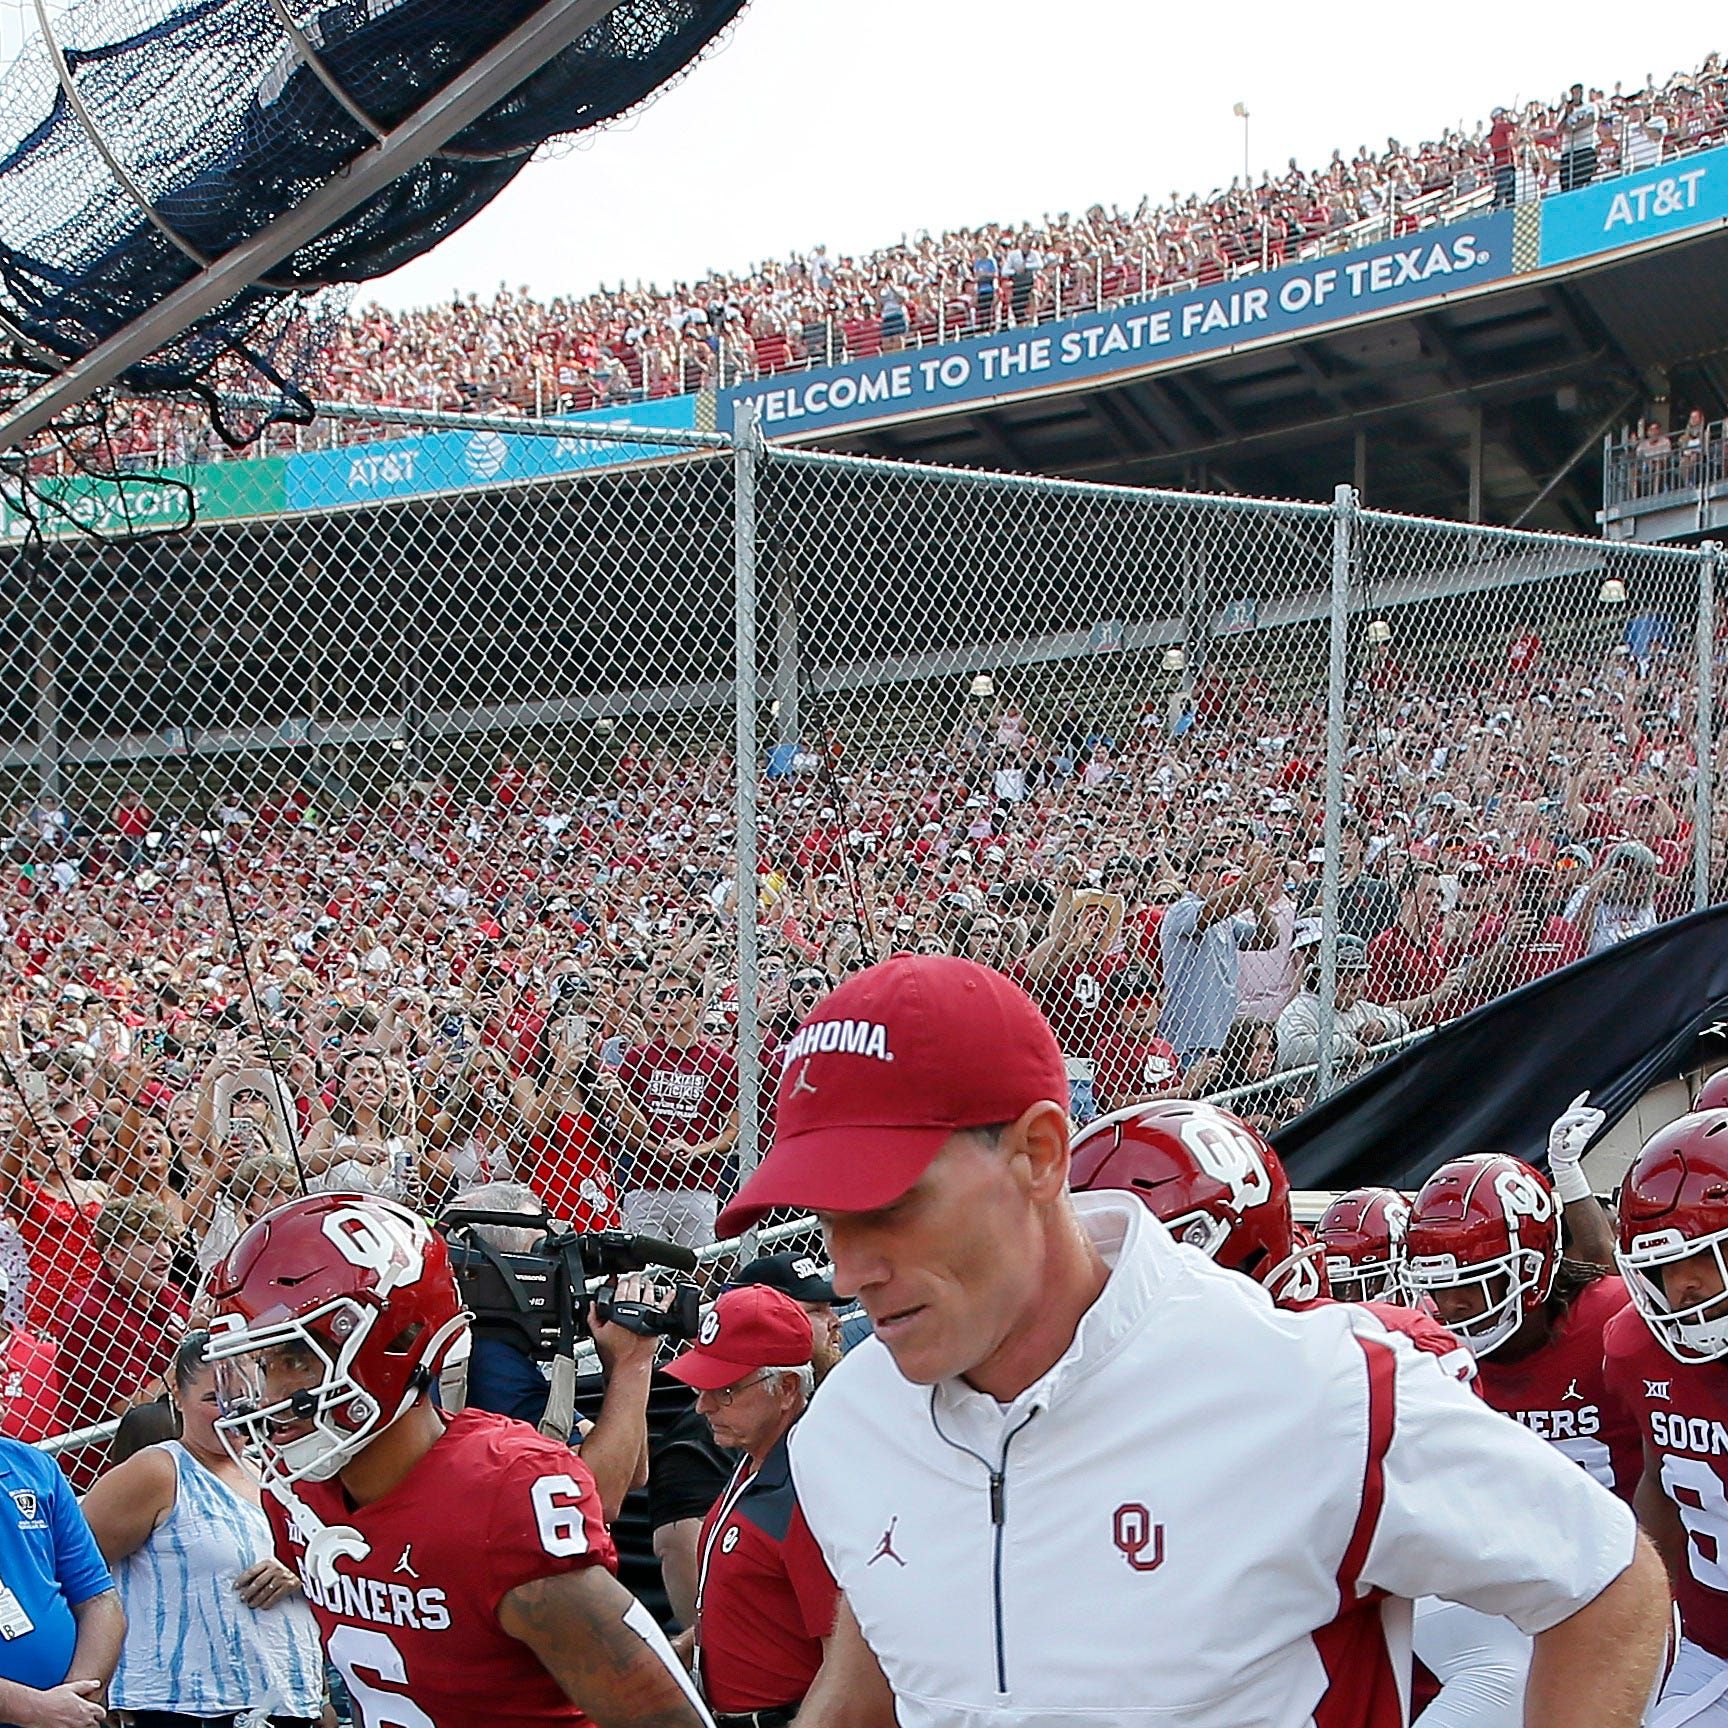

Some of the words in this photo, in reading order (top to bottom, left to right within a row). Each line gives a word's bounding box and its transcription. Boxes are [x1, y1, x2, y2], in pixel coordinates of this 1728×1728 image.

[1603, 169, 1706, 231] AT&T
[919, 355, 971, 391] TO
[978, 338, 1052, 381] THE
[1059, 311, 1172, 365] STATE
[1182, 287, 1269, 338] FAIR
[1279, 269, 1337, 313] OF
[348, 451, 420, 489] AT&T
[1180, 1118, 1272, 1215] OU
[1494, 1170, 1551, 1224] OU
[322, 1205, 426, 1289] OU
[699, 1309, 721, 1345] OU
[1643, 1378, 1672, 1401] XII
[530, 1474, 591, 1558] 6
[722, 1525, 739, 1554] OU
[1113, 1502, 1166, 1572] OU
